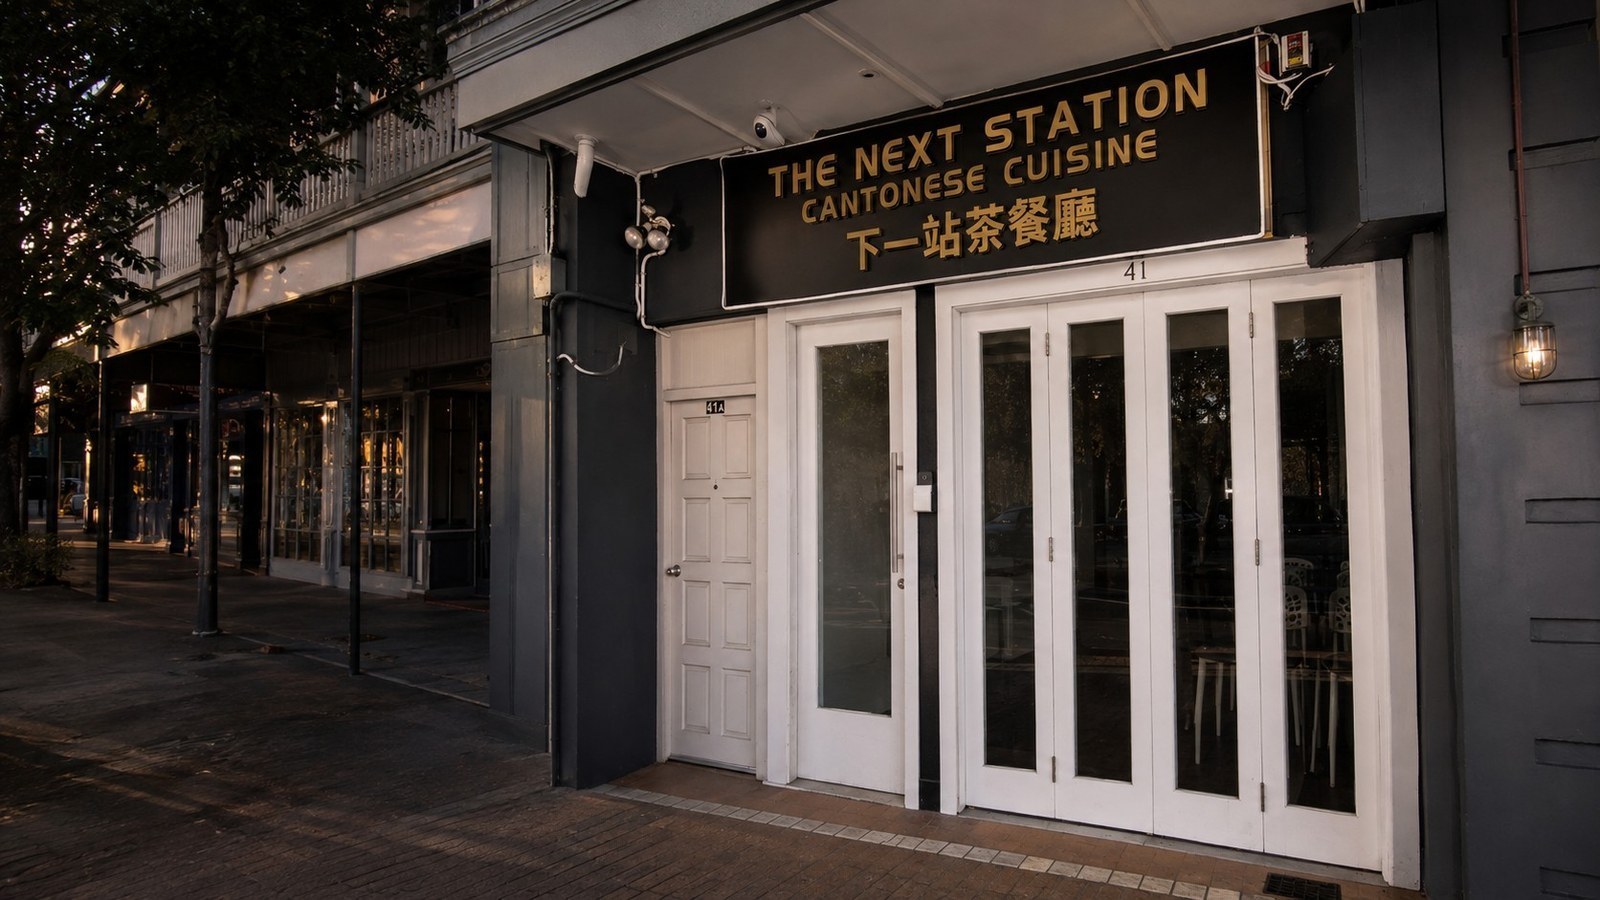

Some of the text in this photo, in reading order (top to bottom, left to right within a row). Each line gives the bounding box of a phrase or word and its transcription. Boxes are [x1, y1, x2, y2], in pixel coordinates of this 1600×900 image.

[768, 68, 1207, 198] THE NEXT STATION
[802, 129, 1157, 224] CANTONESE CUISINE
[847, 188, 1099, 270] 下一站茶餐廳
[1124, 260, 1146, 281] 41
[706, 401, 725, 413] 41A
